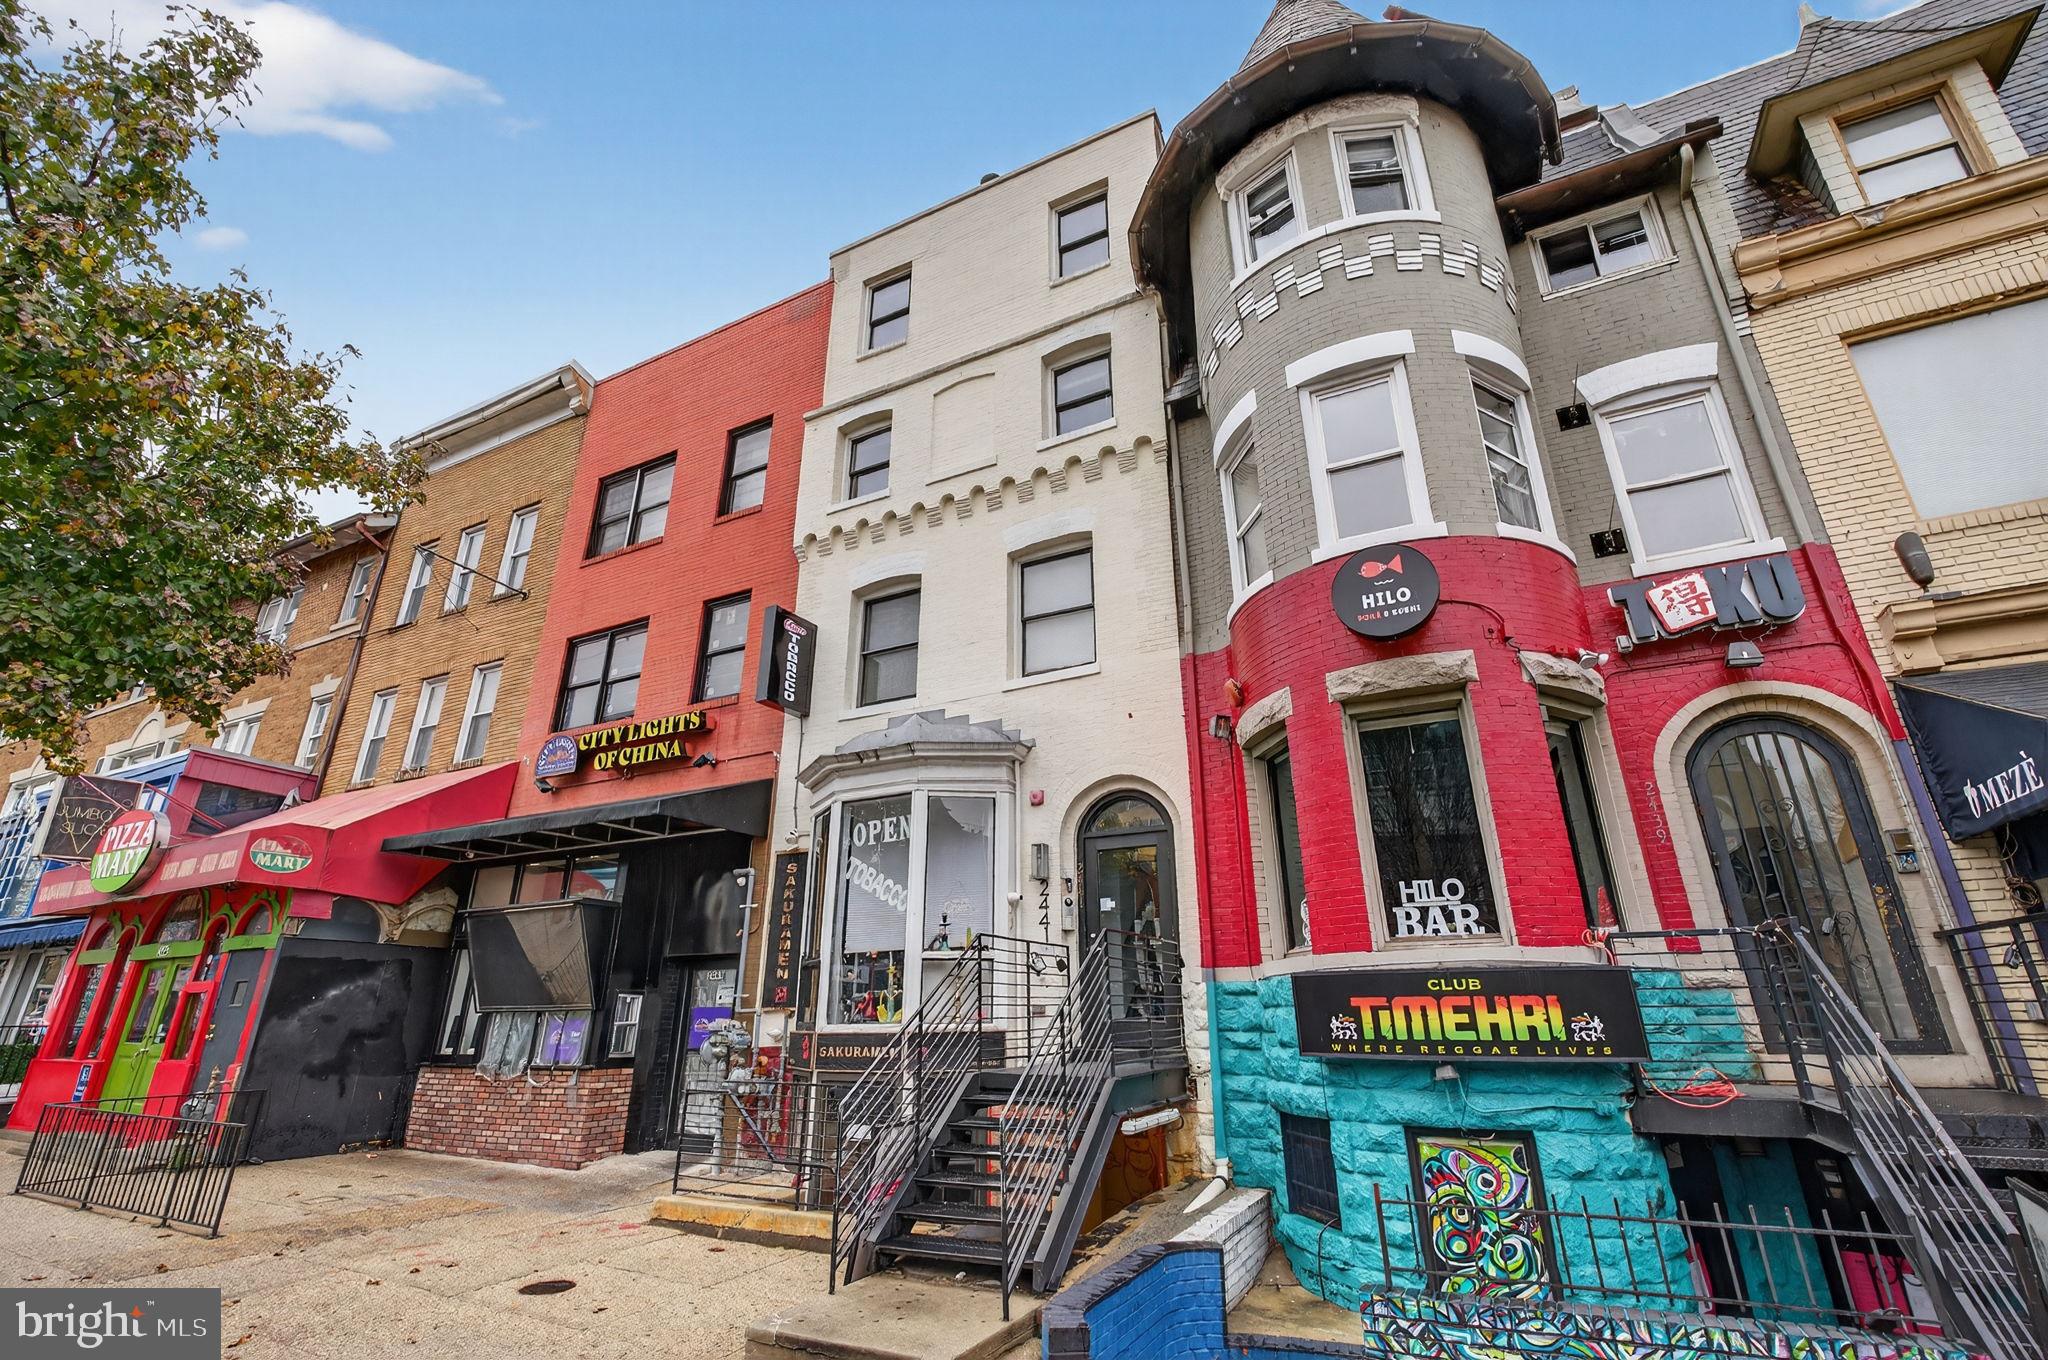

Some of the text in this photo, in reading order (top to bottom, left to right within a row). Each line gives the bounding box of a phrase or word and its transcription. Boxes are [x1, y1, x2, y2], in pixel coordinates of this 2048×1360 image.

[1361, 587, 1412, 609] HILO
[783, 631, 801, 702] TOBACCO
[579, 708, 702, 751] CITY LIGHTS
[593, 739, 682, 771] OF CHINA
[1976, 750, 2045, 813] MEZÈ
[56, 804, 112, 823] JUMBO
[102, 819, 156, 853] PIZZA
[852, 814, 911, 848] OPEN
[91, 846, 150, 879] MART
[254, 852, 306, 870] MART
[845, 855, 908, 912] TOBACCO
[1398, 877, 1465, 904] HILO
[776, 861, 799, 980] SAKURAMEN
[1038, 878, 1050, 943] 2441
[1392, 903, 1486, 937] BAR
[1427, 977, 1482, 991] CLUB
[1331, 1043, 1613, 1056] WHERE REGGAE LIVES
